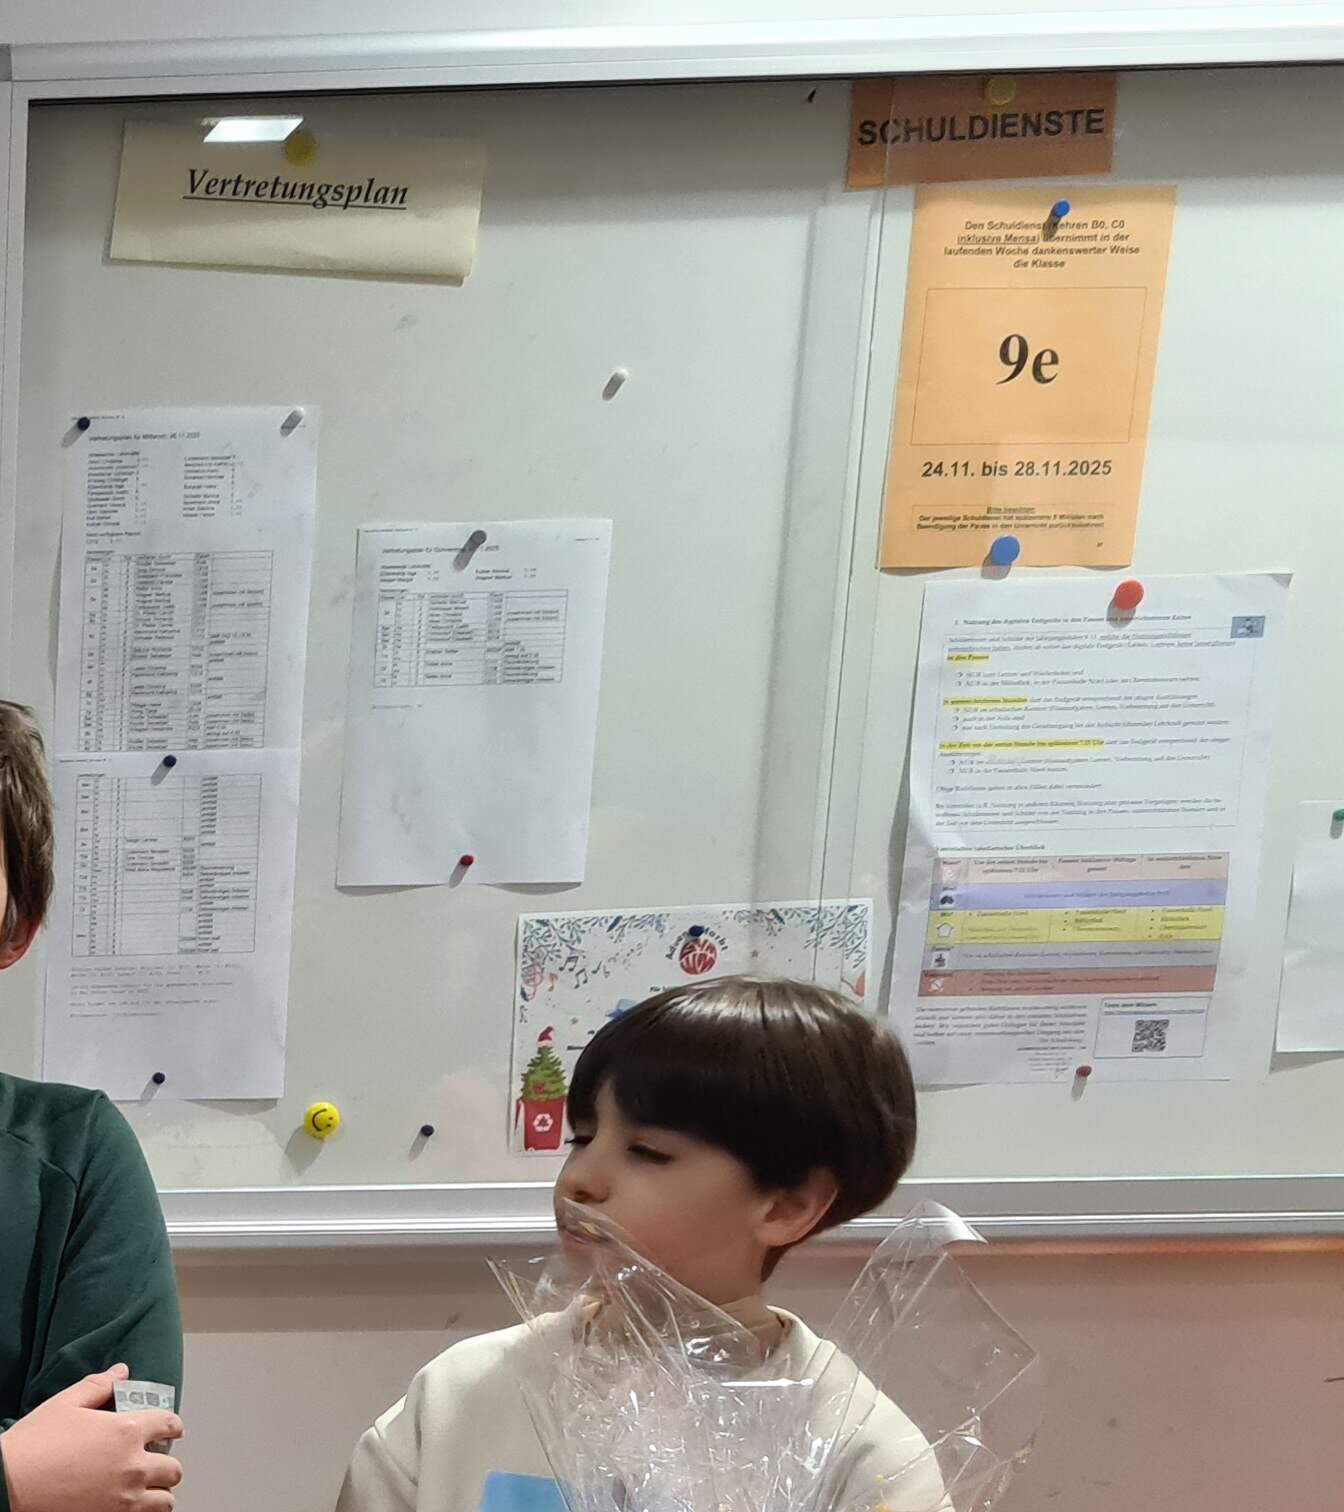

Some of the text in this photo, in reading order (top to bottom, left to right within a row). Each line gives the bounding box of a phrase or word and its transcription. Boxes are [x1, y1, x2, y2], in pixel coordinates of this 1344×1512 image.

[857, 108, 1105, 145] SCHULDIENSTE
[183, 169, 408, 210] Vertretungsplan
[995, 333, 1059, 385] 9e
[921, 460, 1112, 477] 24.11. bis 28.11.2025
